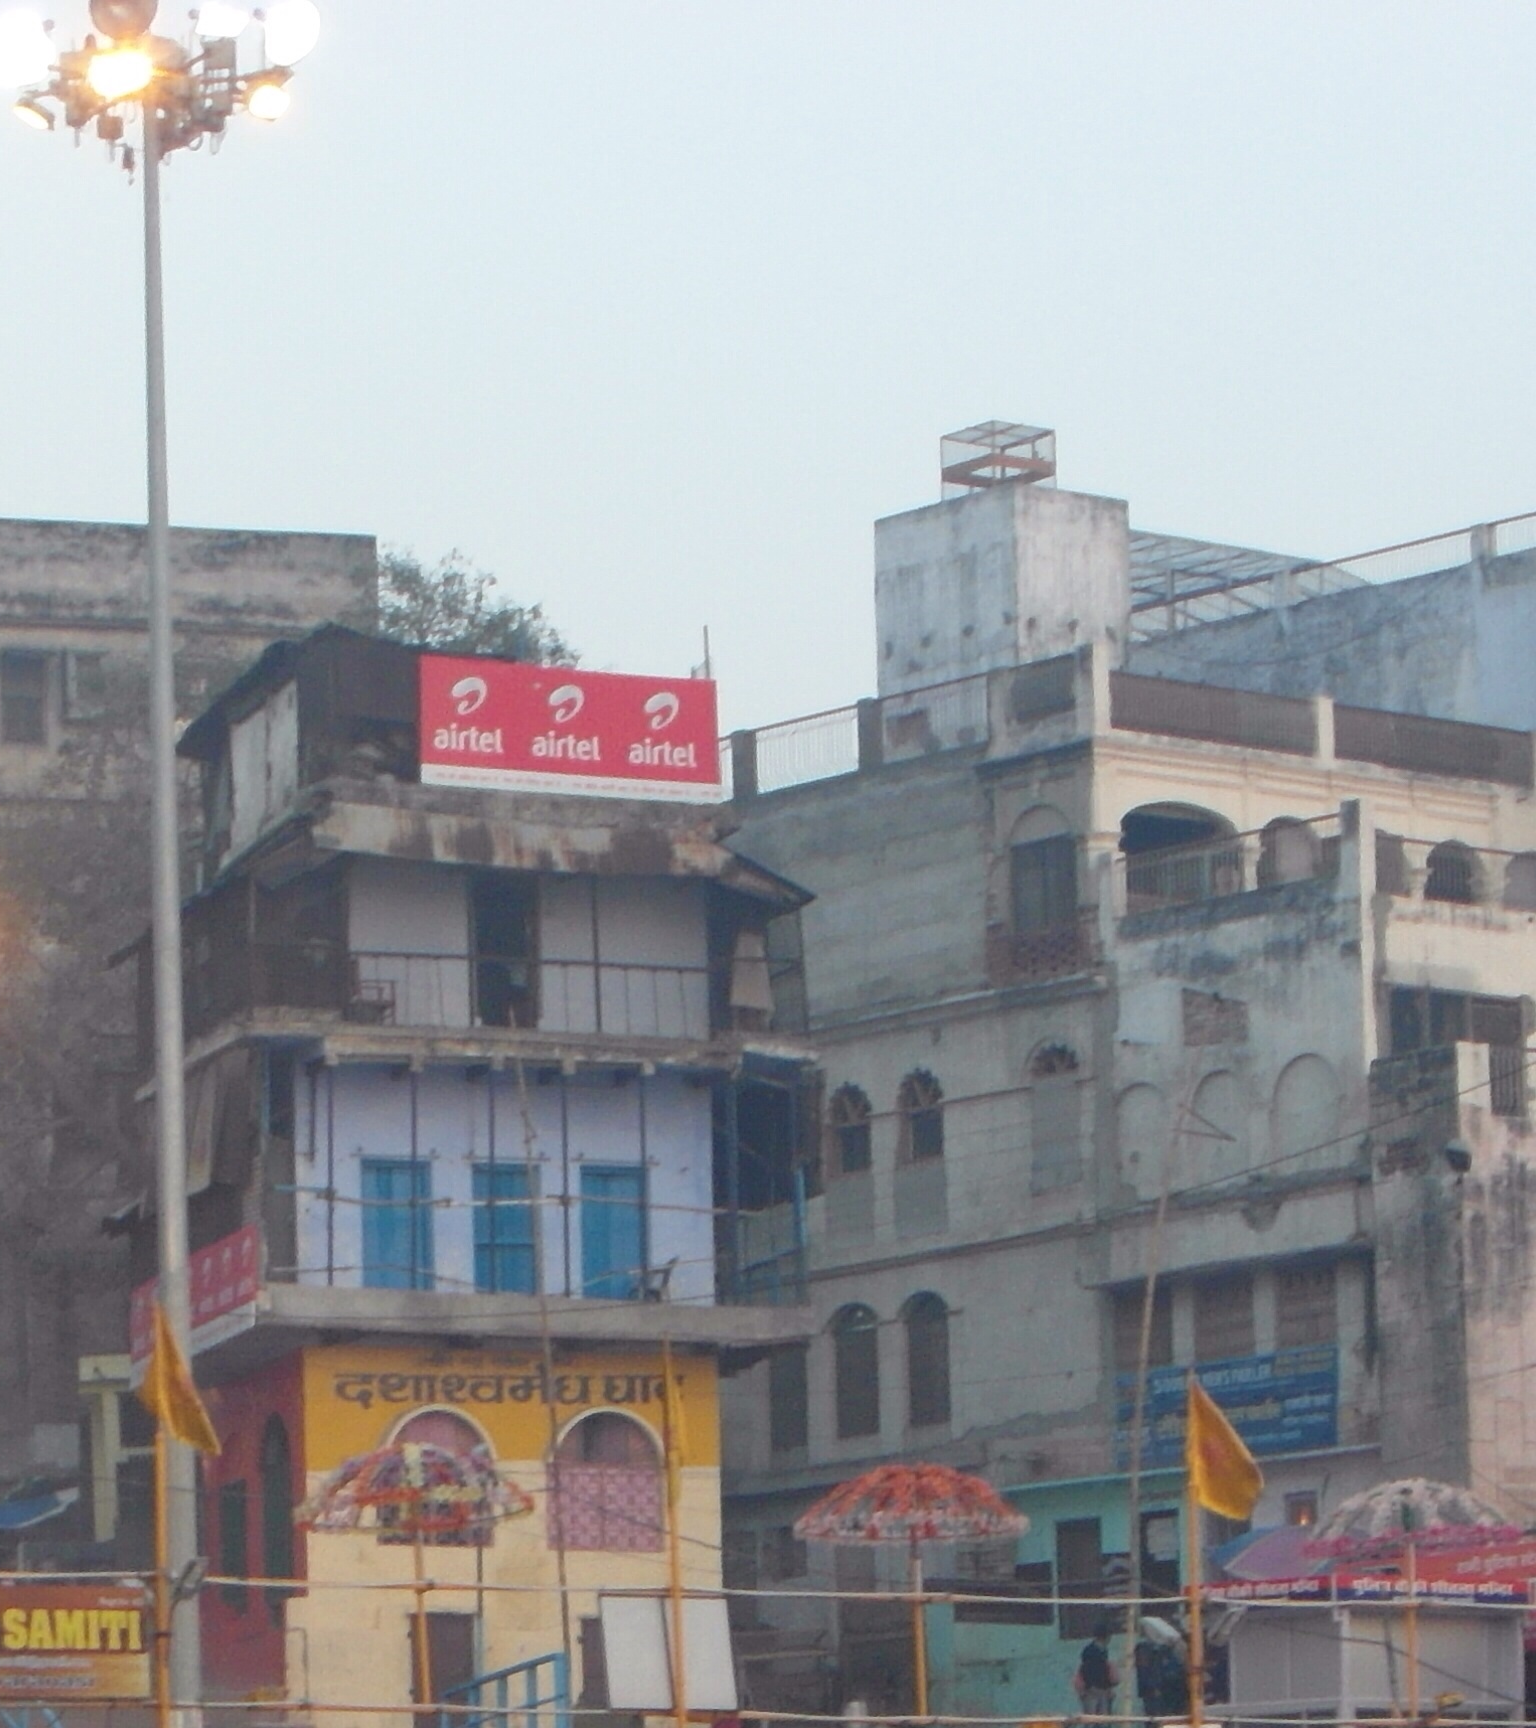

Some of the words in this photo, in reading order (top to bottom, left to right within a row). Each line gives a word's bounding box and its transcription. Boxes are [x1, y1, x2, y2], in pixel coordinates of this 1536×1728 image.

[434, 722, 504, 754] airtel
[531, 730, 602, 761] airtel
[629, 738, 698, 768] airtel
[2, 1608, 141, 1650] SAMITI
